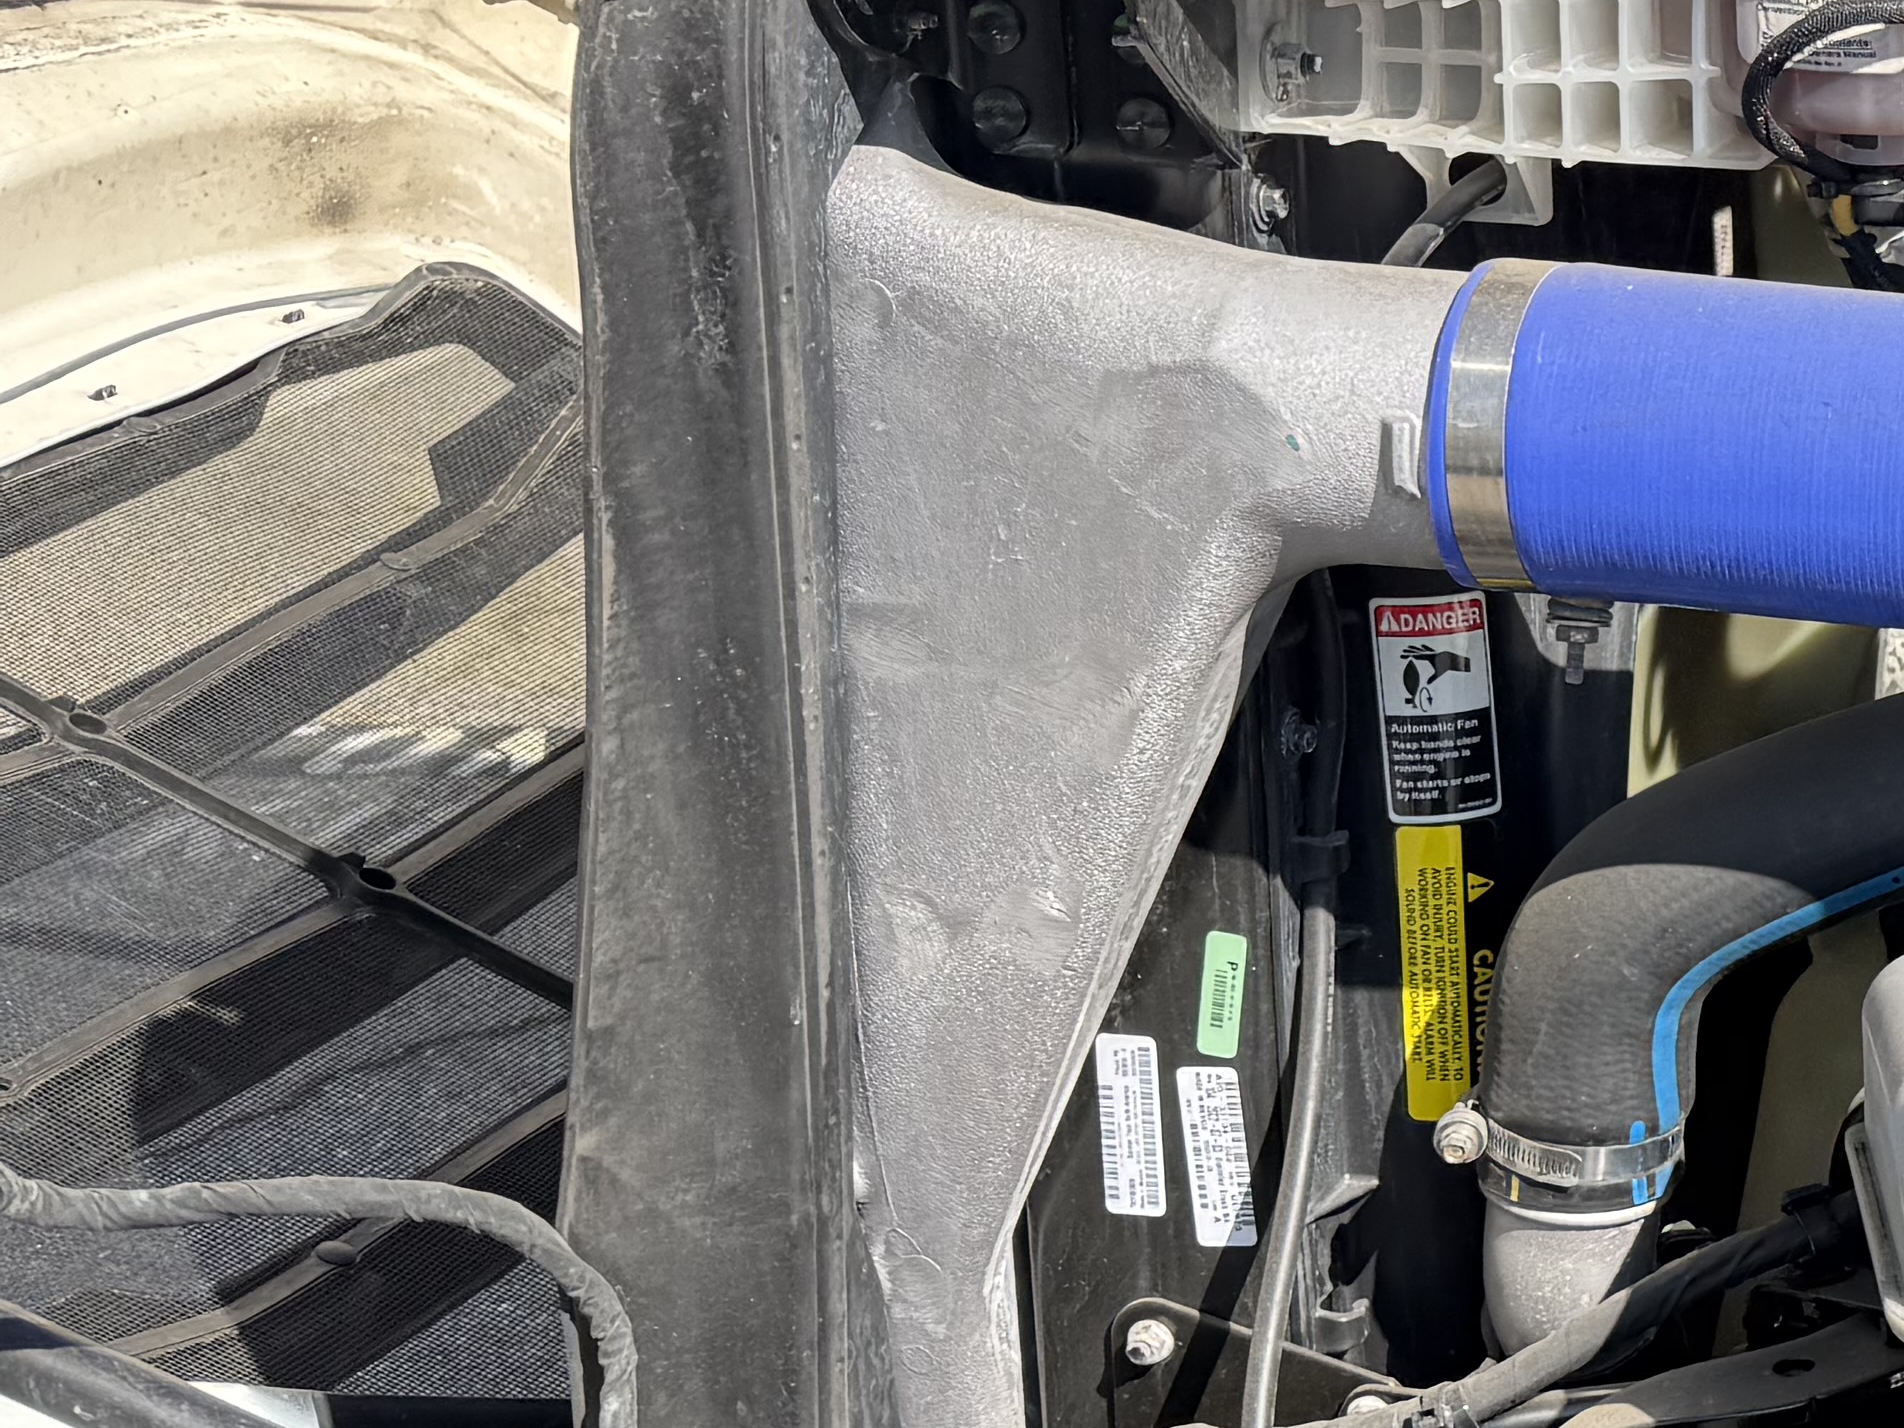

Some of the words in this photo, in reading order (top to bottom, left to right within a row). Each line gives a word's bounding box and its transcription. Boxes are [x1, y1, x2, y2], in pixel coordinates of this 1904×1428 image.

[1400, 607, 1481, 632] DANGER
[1391, 722, 1454, 734] Automatic
[1457, 718, 1478, 730] Fan
[1392, 739, 1419, 751] Keep
[1421, 737, 1454, 748] hands
[1457, 735, 1481, 746] clear
[1423, 750, 1459, 762] engine
[1396, 778, 1414, 789] Fan
[1397, 790, 1410, 802] by
[1431, 868, 1443, 900] AVOID
[1419, 924, 1431, 941] ON
[1420, 945, 1432, 966] FAN
[1435, 946, 1446, 973] TURN
[1438, 1050, 1450, 1081] WHEN
[1453, 1068, 1464, 1081] TO
